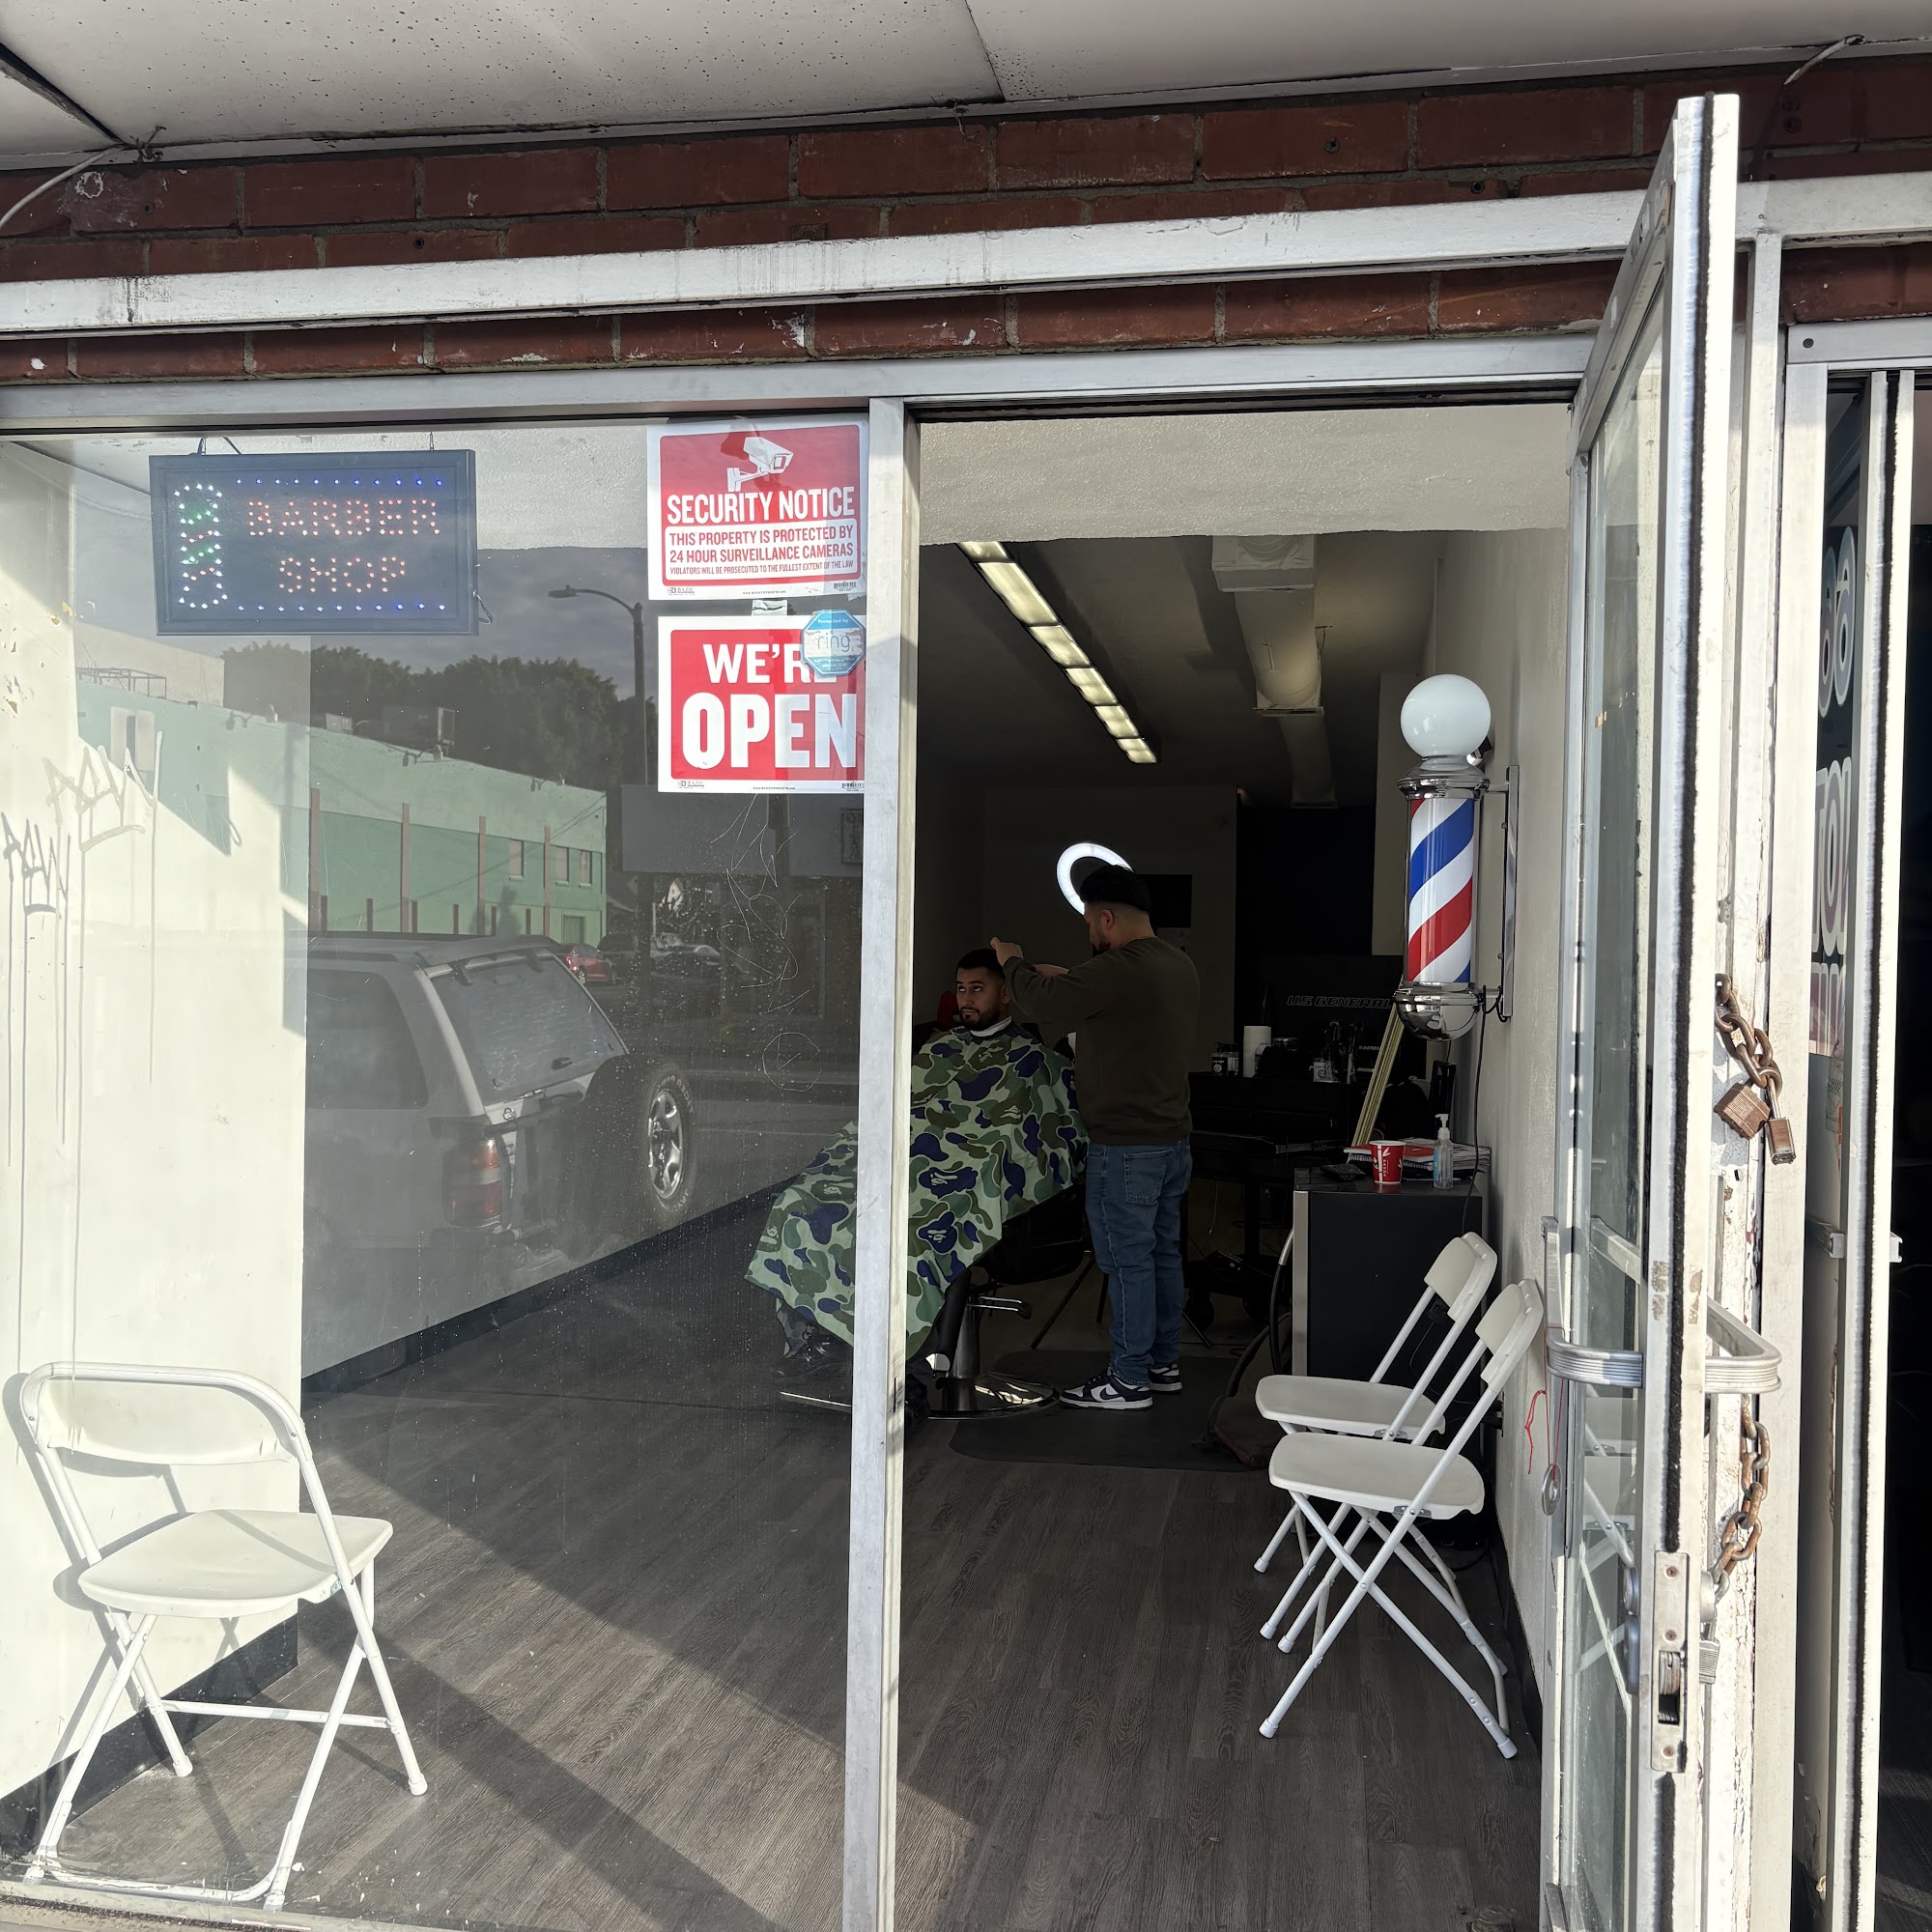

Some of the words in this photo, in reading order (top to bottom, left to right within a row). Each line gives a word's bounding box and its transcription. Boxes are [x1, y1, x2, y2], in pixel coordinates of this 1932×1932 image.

[248, 499, 440, 536] BARBER
[667, 491, 774, 525] SECURITY
[779, 486, 855, 520] NOTICE
[669, 532, 696, 546] THIS
[698, 530, 757, 546] PROPERTY
[759, 529, 770, 543] IS
[773, 526, 837, 543] PROTECTED
[838, 525, 853, 539] BY
[669, 550, 684, 563] 24
[686, 549, 718, 563] HOUR
[720, 546, 800, 562] SURVEILLANCE
[802, 542, 854, 559] CAMERAS
[669, 566, 700, 575] VIOLATORS
[700, 566, 715, 575] WILL
[724, 565, 758, 574] PROSECUTED
[779, 563, 802, 572] FULLEST
[802, 561, 823, 571] EXTENT
[823, 561, 831, 570] OF
[831, 560, 841, 569] THE
[841, 559, 854, 568] LAW
[279, 556, 406, 593] SHOP
[817, 633, 851, 653] ring
[702, 642, 838, 684] WE'R
[682, 692, 857, 770] OPEN
[1314, 996, 1392, 1009] GENERAL
